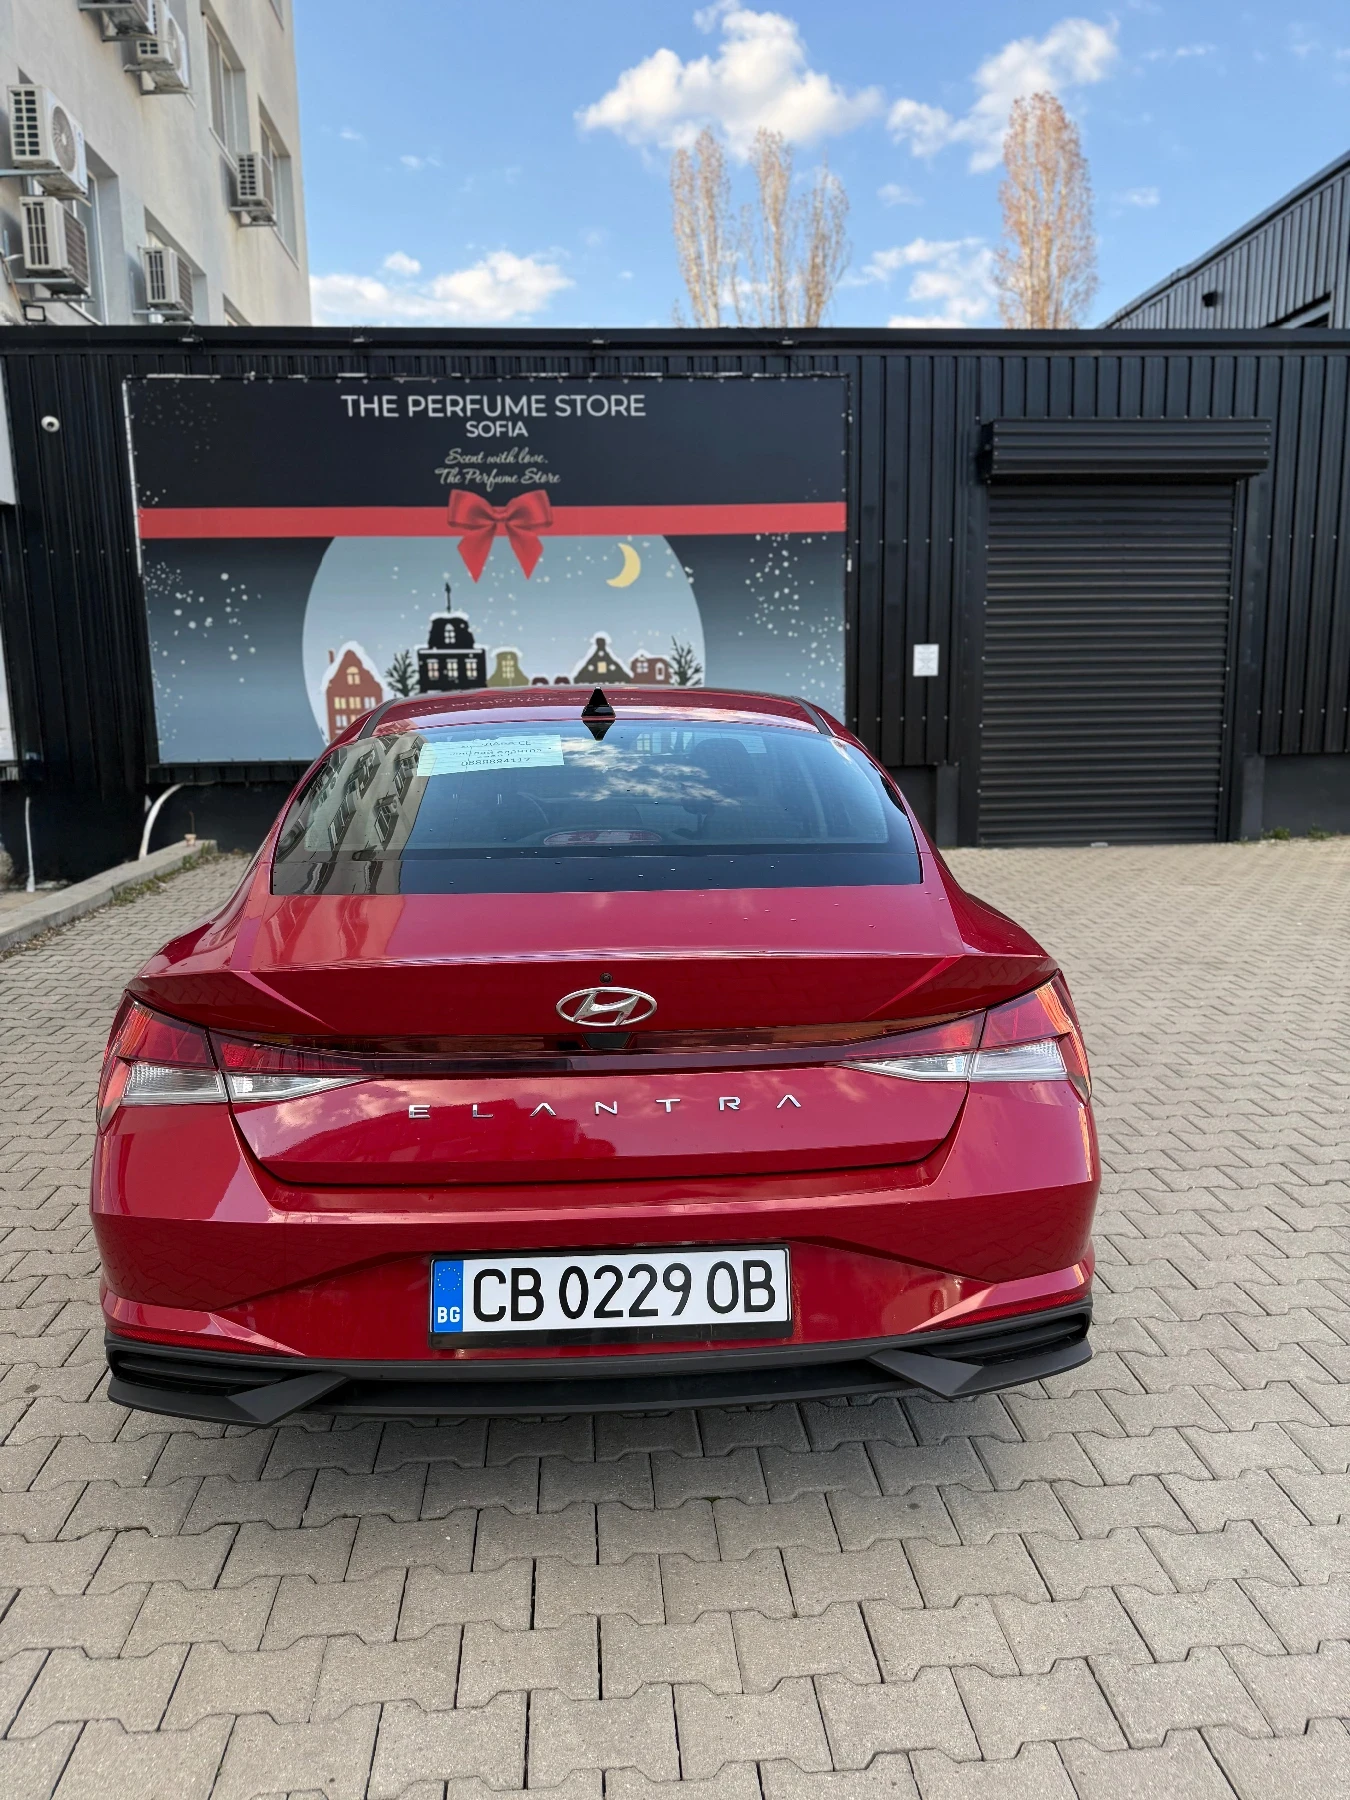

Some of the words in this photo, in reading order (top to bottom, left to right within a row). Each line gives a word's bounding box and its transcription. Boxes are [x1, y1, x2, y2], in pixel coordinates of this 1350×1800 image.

[341, 394, 399, 418] THE
[407, 394, 546, 418] PERFUME
[554, 393, 646, 417] STORE
[465, 420, 528, 438] SOFIA
[444, 449, 484, 465] Scent
[486, 447, 516, 465] with
[518, 447, 549, 464] love.
[435, 468, 462, 485] The
[464, 468, 518, 491] Perfume
[520, 467, 561, 485] Store
[408, 1094, 802, 1119] ELANTRA
[473, 1268, 544, 1323] CB
[558, 1262, 692, 1320] 0229
[706, 1259, 776, 1315] OB
[437, 1306, 461, 1323] BG
